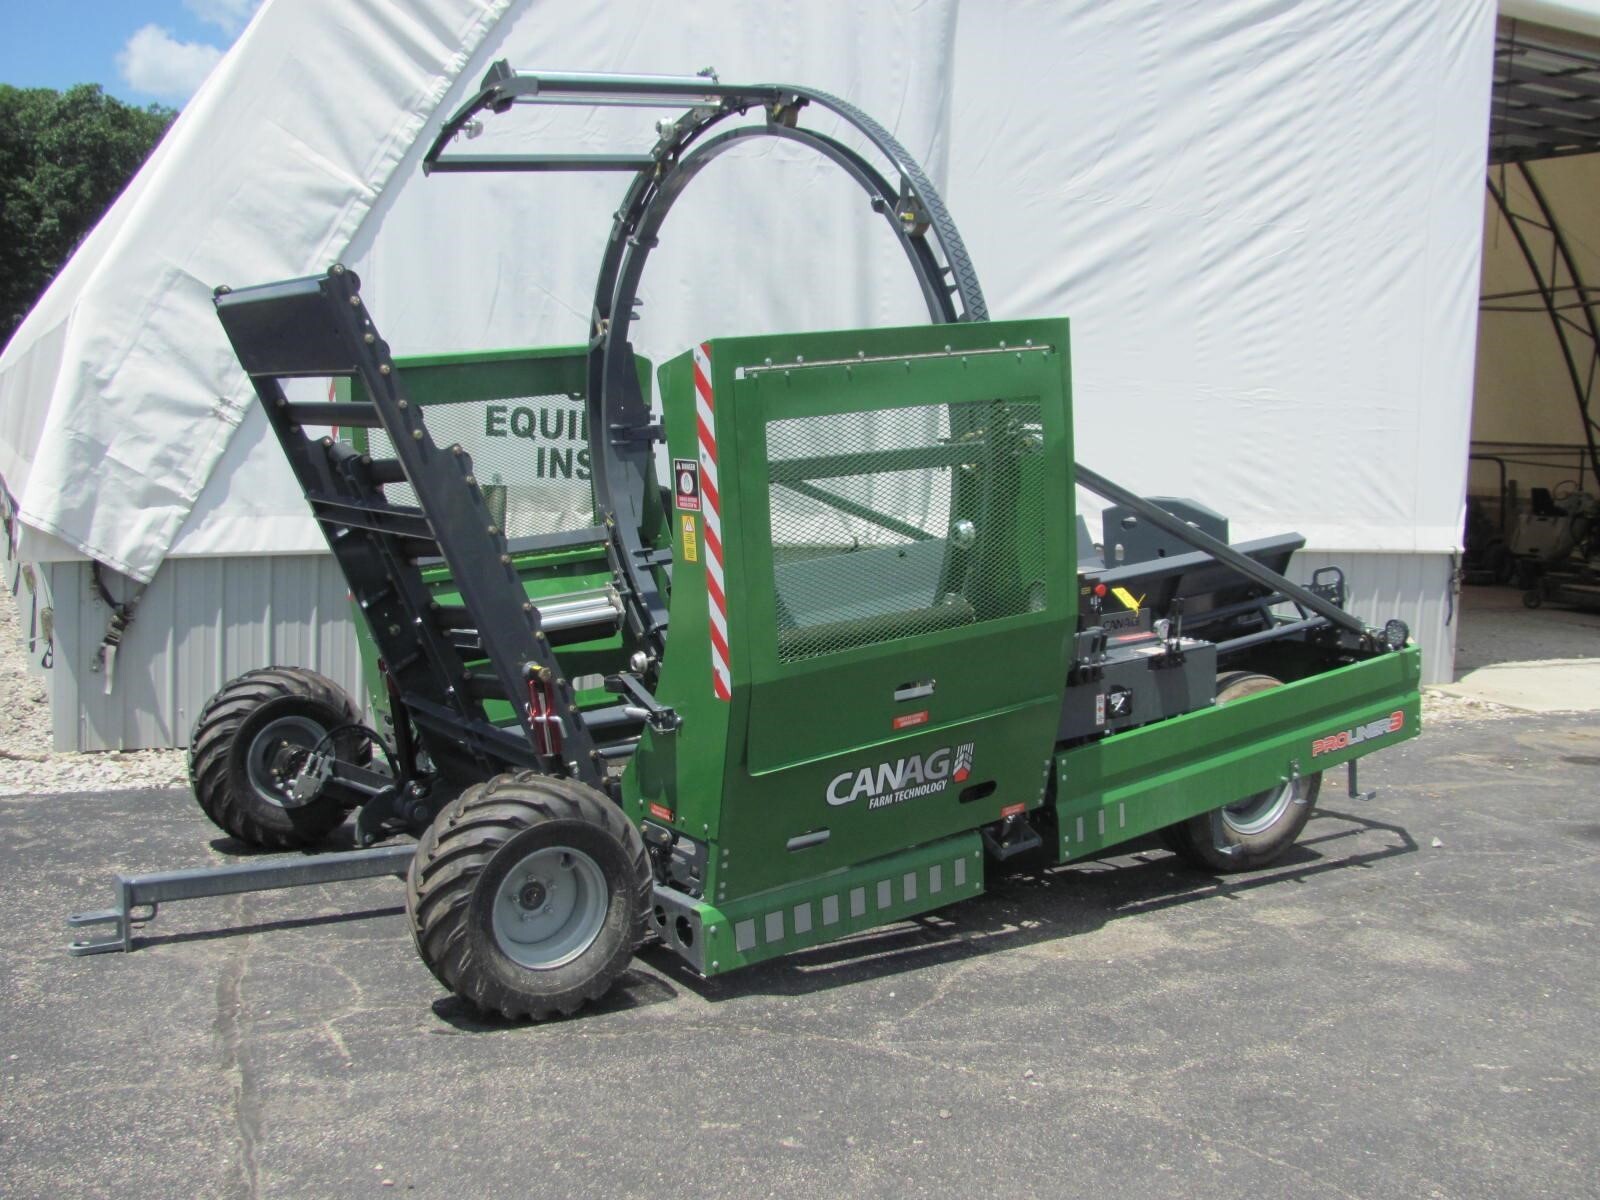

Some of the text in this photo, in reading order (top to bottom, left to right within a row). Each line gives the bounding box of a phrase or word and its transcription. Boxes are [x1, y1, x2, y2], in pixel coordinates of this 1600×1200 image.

[826, 747, 950, 806] CANAG
[868, 779, 948, 810] FARM TECHNOLOGY
